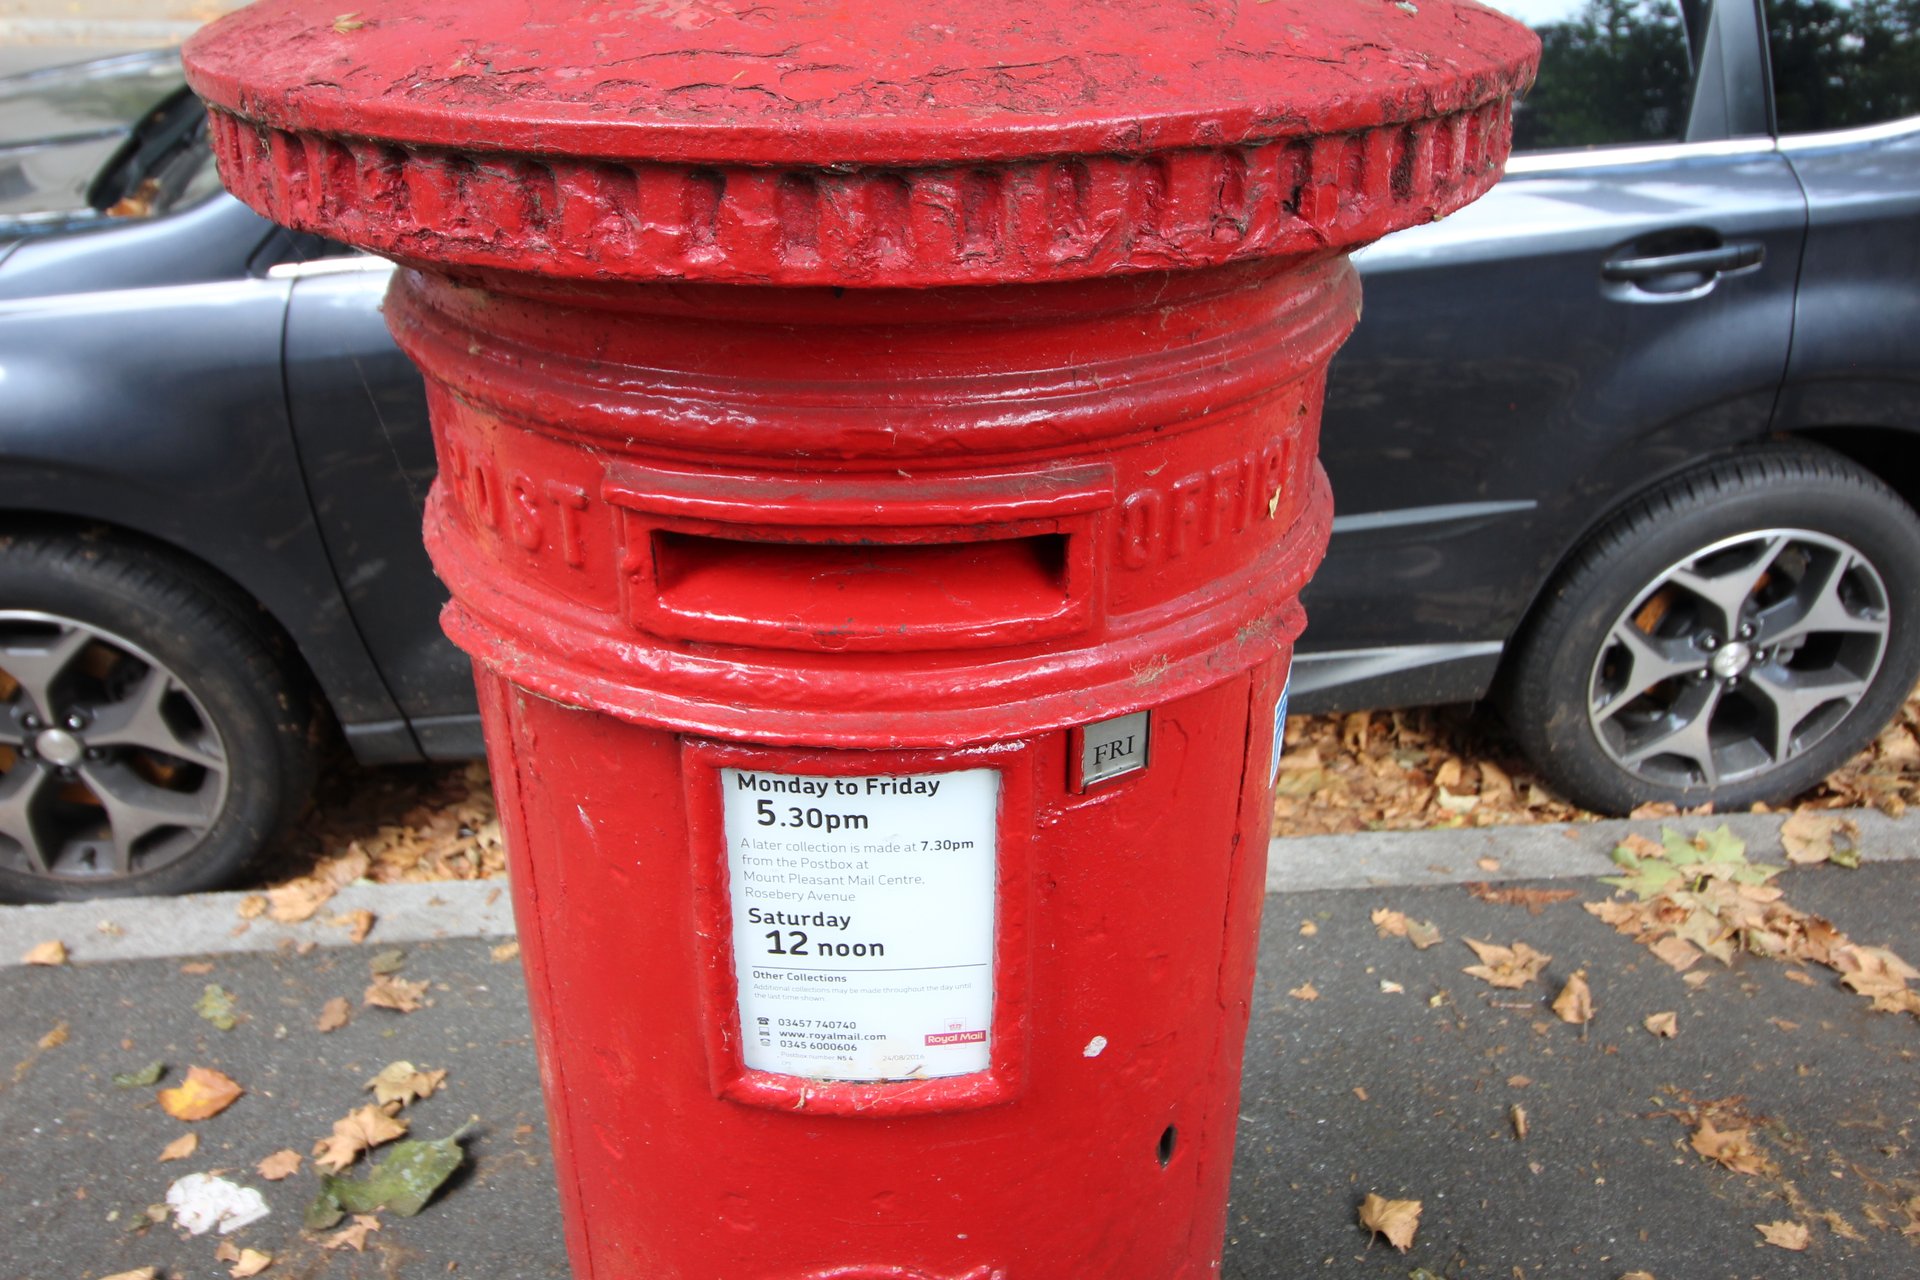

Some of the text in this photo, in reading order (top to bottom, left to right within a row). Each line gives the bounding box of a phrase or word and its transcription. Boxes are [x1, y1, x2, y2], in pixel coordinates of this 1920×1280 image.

[445, 427, 589, 569] POST
[1093, 735, 1136, 766] FRI
[737, 773, 941, 798] Monday to Friday
[756, 799, 868, 833] 5.30pm
[740, 838, 974, 853] A later collection is made at 7.30pm
[741, 855, 869, 870] from the Postbox at
[743, 871, 785, 884] Mount
[788, 873, 845, 886] Pleasant
[848, 874, 875, 886] Mail
[745, 887, 856, 902] Rosebery Avenue
[748, 908, 851, 931] Saturday
[765, 930, 884, 957] 12 noon
[753, 970, 847, 983] Other Collections
[753, 983, 790, 992] Additional
[883, 986, 925, 995] throughout
[926, 984, 938, 992] the
[940, 984, 953, 992] day
[778, 1018, 857, 1030] 03457 740740
[779, 1031, 887, 1043] www.royalmail.com
[928, 1031, 983, 1045] Royal Mail
[780, 1040, 857, 1052] 0345 6000606
